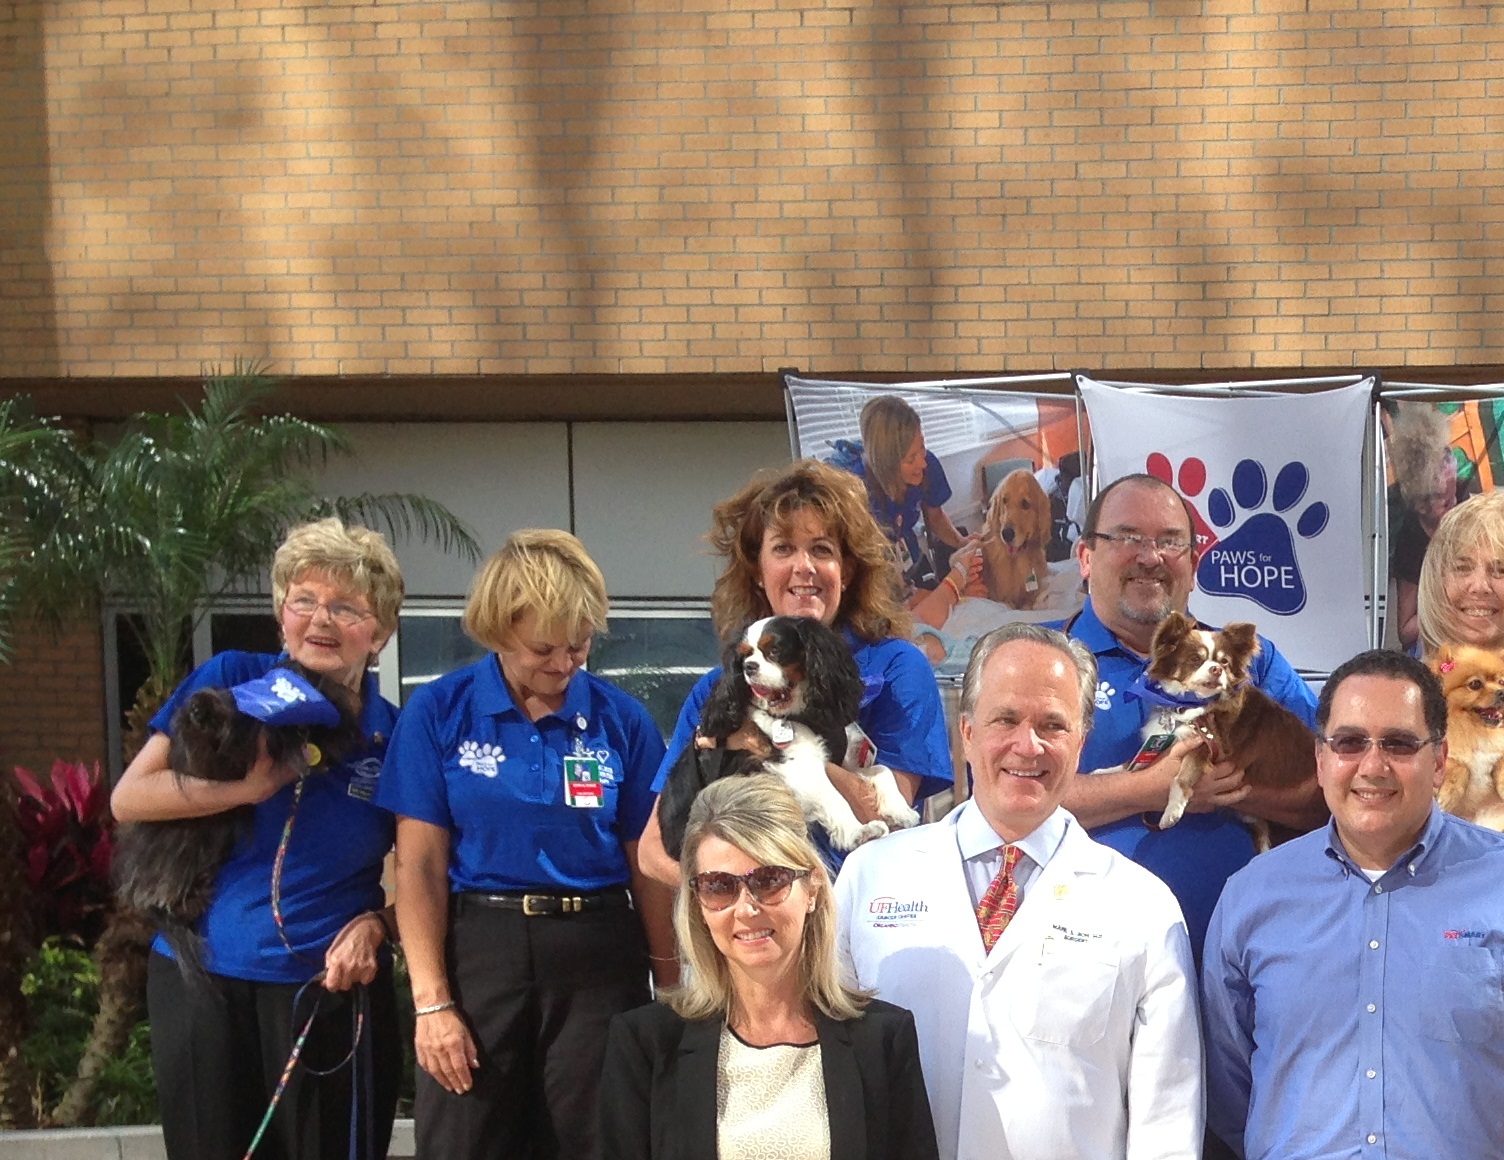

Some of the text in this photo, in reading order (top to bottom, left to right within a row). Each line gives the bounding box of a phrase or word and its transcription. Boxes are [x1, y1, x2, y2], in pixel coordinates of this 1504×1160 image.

[1211, 550, 1272, 564] PAWS for
[1220, 565, 1295, 588] HOPE
